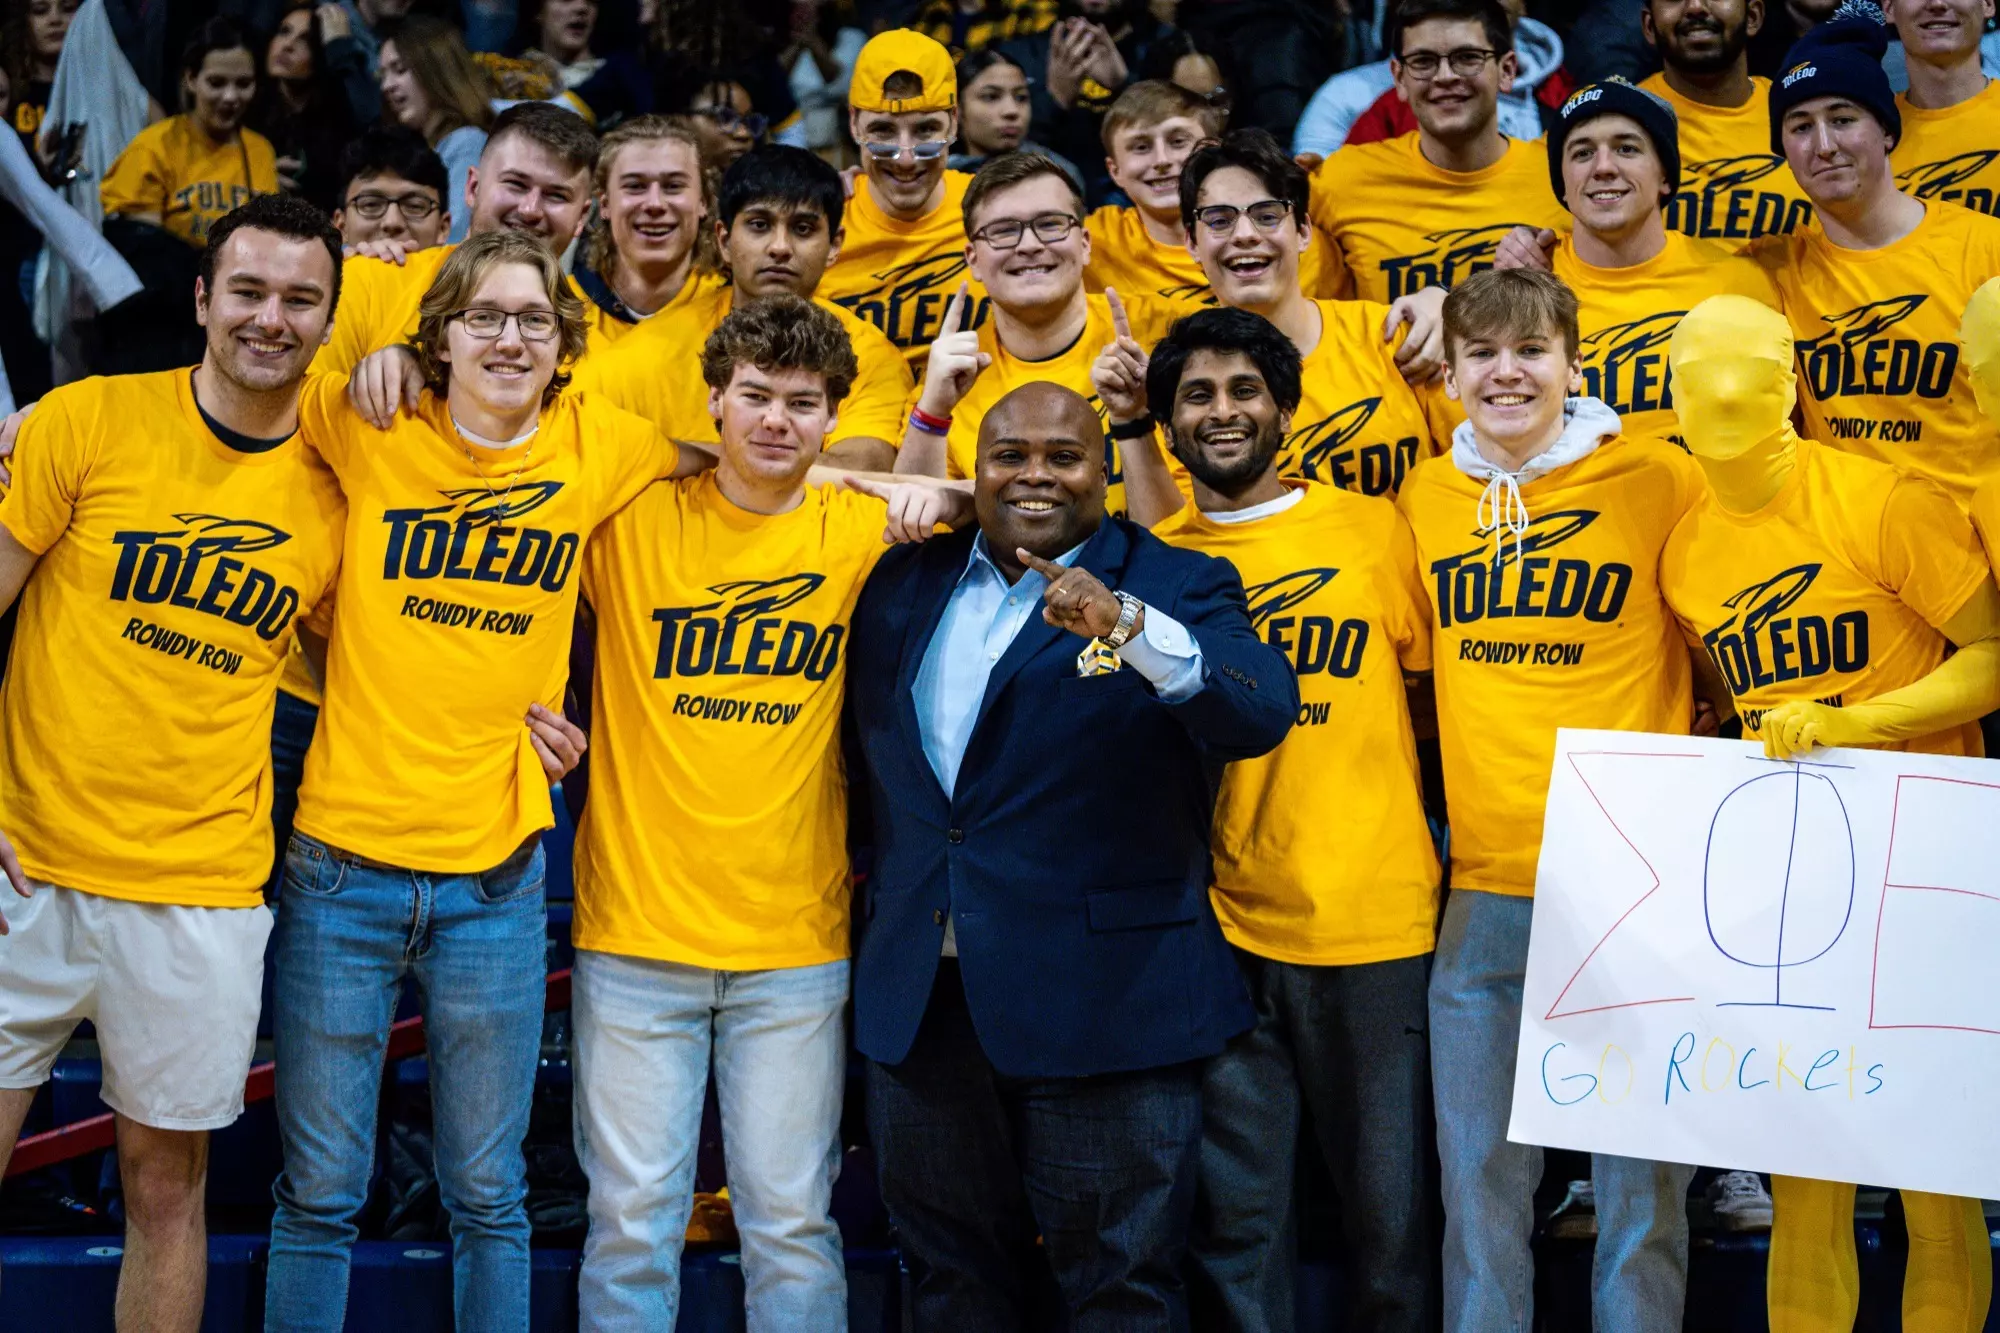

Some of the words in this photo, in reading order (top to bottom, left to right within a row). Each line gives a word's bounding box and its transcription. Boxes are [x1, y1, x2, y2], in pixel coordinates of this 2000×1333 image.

[1782, 67, 1817, 89] TOLEDO
[1561, 89, 1603, 119] TOLEDO
[1666, 190, 1812, 238] OLEDO
[1824, 417, 1877, 439] OWDY
[1879, 420, 1922, 442] ROW
[382, 508, 579, 592] TOLEDO
[110, 531, 299, 641] TOLEDO
[1431, 554, 1632, 628] TOLEDO
[401, 595, 482, 628] ROWDY
[480, 609, 533, 635] ROW
[122, 617, 201, 660] ROWDY
[197, 643, 243, 675] ROW
[652, 607, 845, 681] TOLEDO
[1459, 639, 1530, 664] ROWDY
[1532, 643, 1585, 665] ROW
[673, 693, 752, 722] ROWDY
[752, 702, 803, 725] ROW
[1295, 702, 1331, 726] OW
